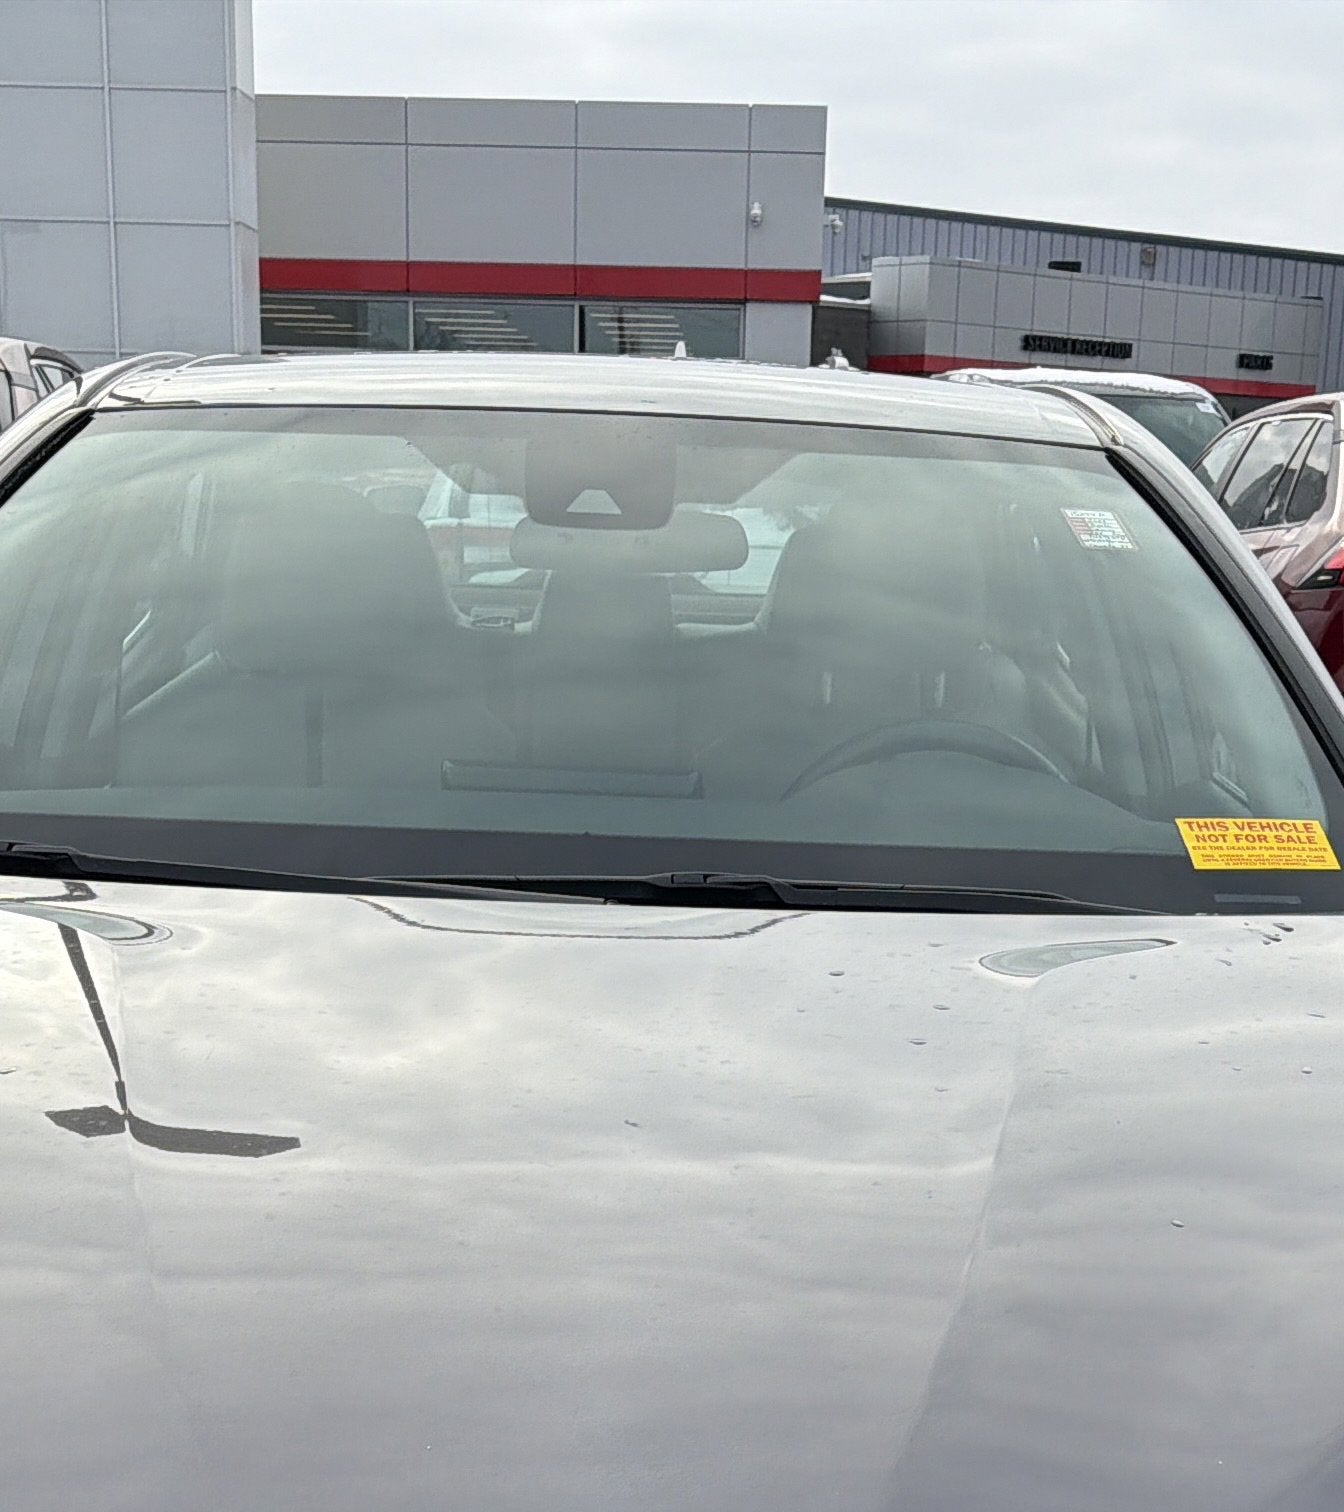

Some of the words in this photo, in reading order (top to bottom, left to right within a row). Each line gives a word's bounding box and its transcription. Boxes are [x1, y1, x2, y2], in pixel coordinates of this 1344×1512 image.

[1183, 821, 1229, 832] THIS
[1232, 821, 1317, 834] VEHICLE
[1195, 833, 1227, 843] NOT
[1234, 834, 1268, 844] FOR
[1274, 834, 1318, 845] SALE
